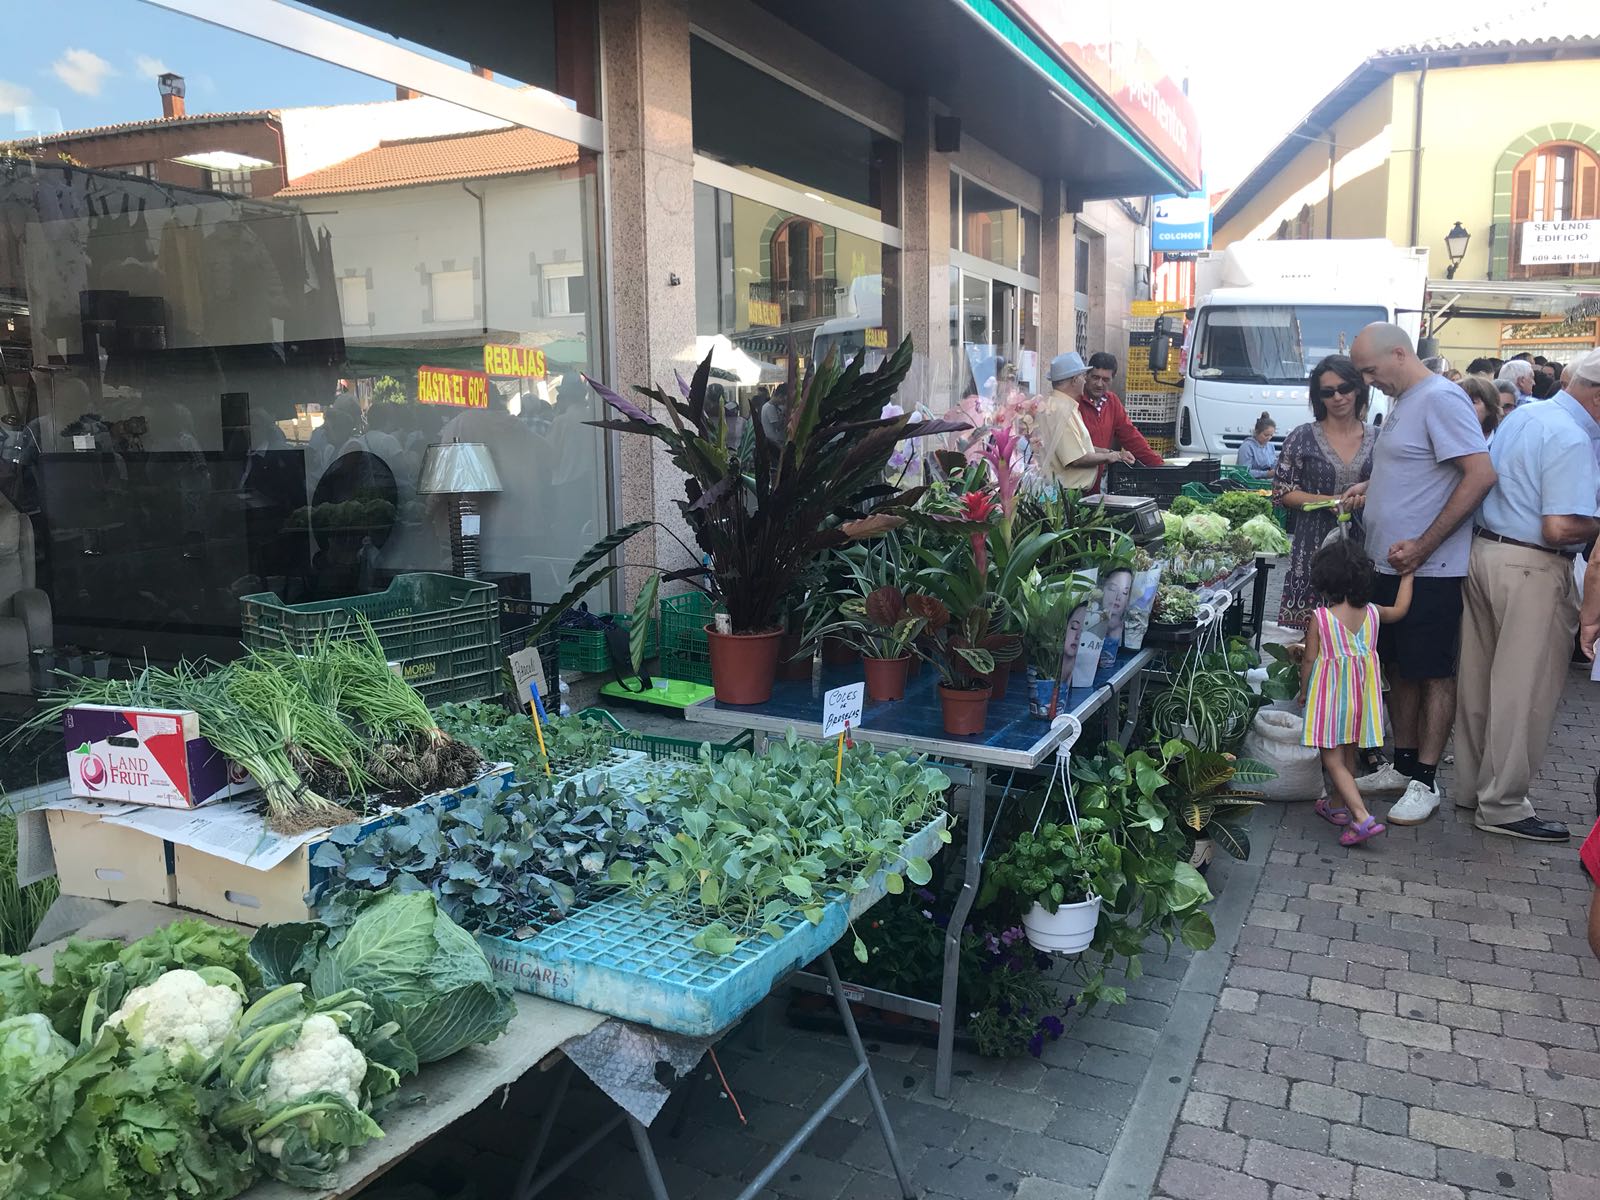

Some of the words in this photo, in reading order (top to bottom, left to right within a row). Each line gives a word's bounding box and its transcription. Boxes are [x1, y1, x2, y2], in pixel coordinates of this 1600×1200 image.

[1158, 231, 1202, 241] COLCHON
[1534, 223, 1548, 231] SE
[1553, 222, 1591, 231] VENDE
[485, 345, 545, 378] REBAJAS
[419, 371, 452, 403] HASTA
[453, 375, 466, 405] EL
[468, 377, 488, 408] 60%
[108, 753, 149, 772] LAND
[111, 768, 150, 787] FRUIT
